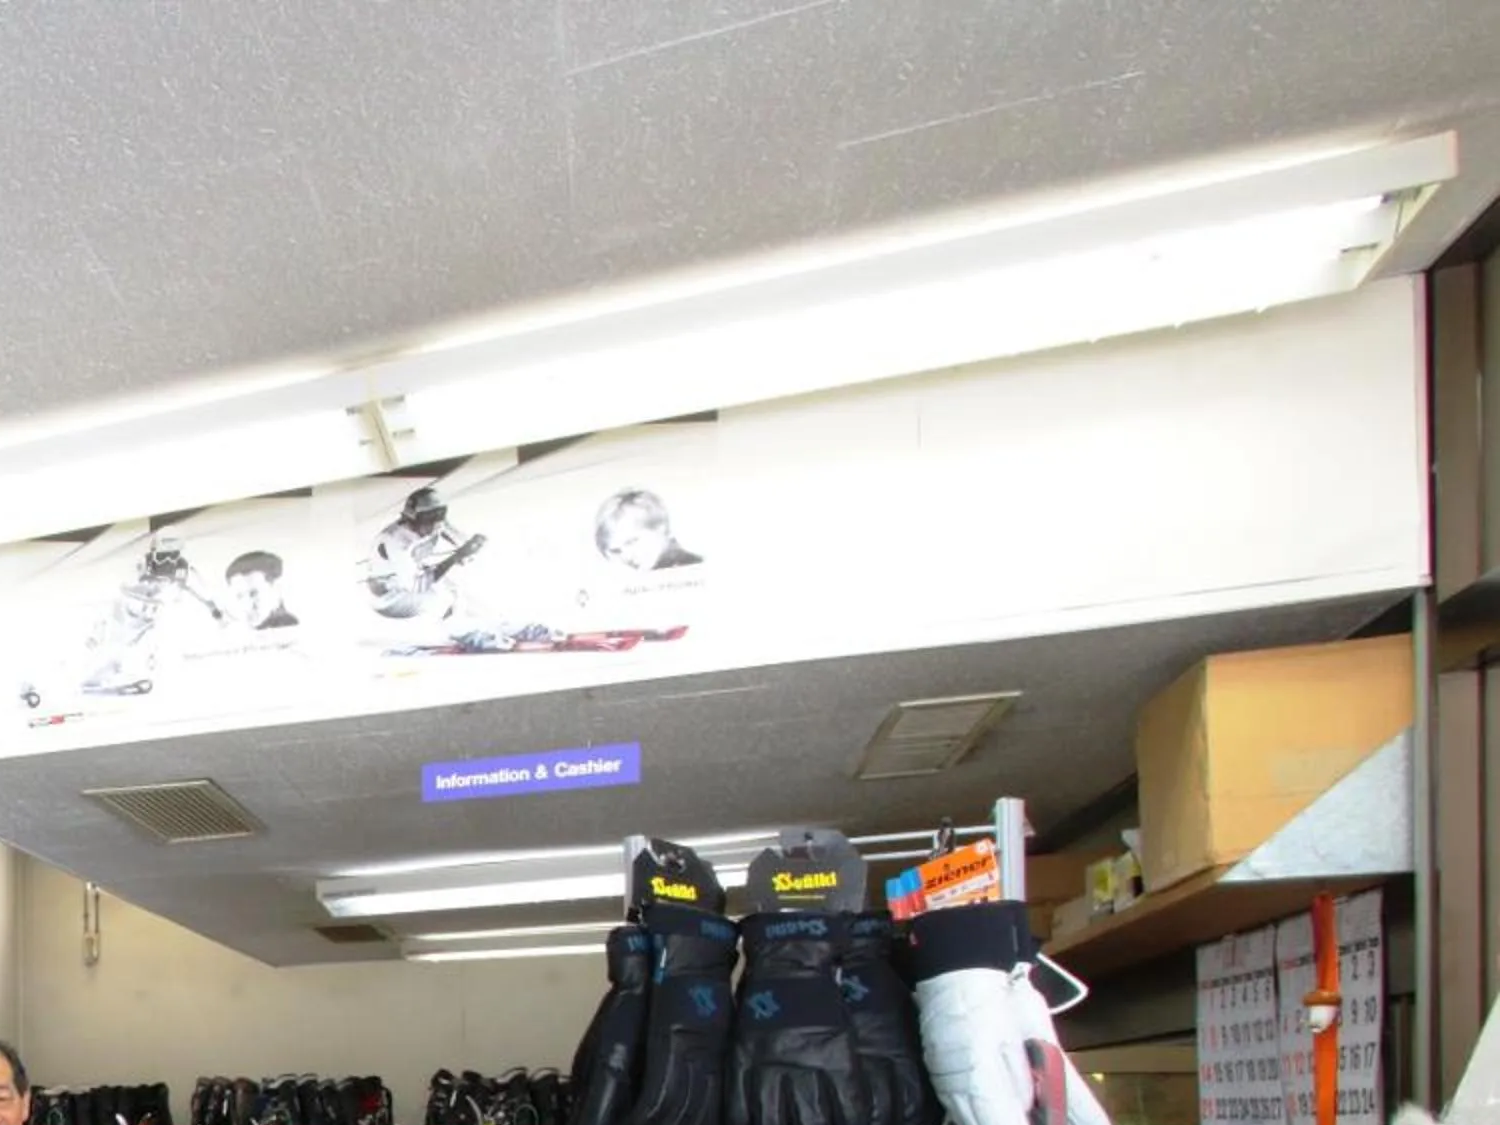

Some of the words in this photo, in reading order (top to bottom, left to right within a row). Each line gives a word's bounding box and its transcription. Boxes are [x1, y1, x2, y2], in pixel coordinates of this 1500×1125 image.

[436, 767, 530, 790] Information
[534, 763, 548, 780] &
[554, 757, 623, 778] Cashier
